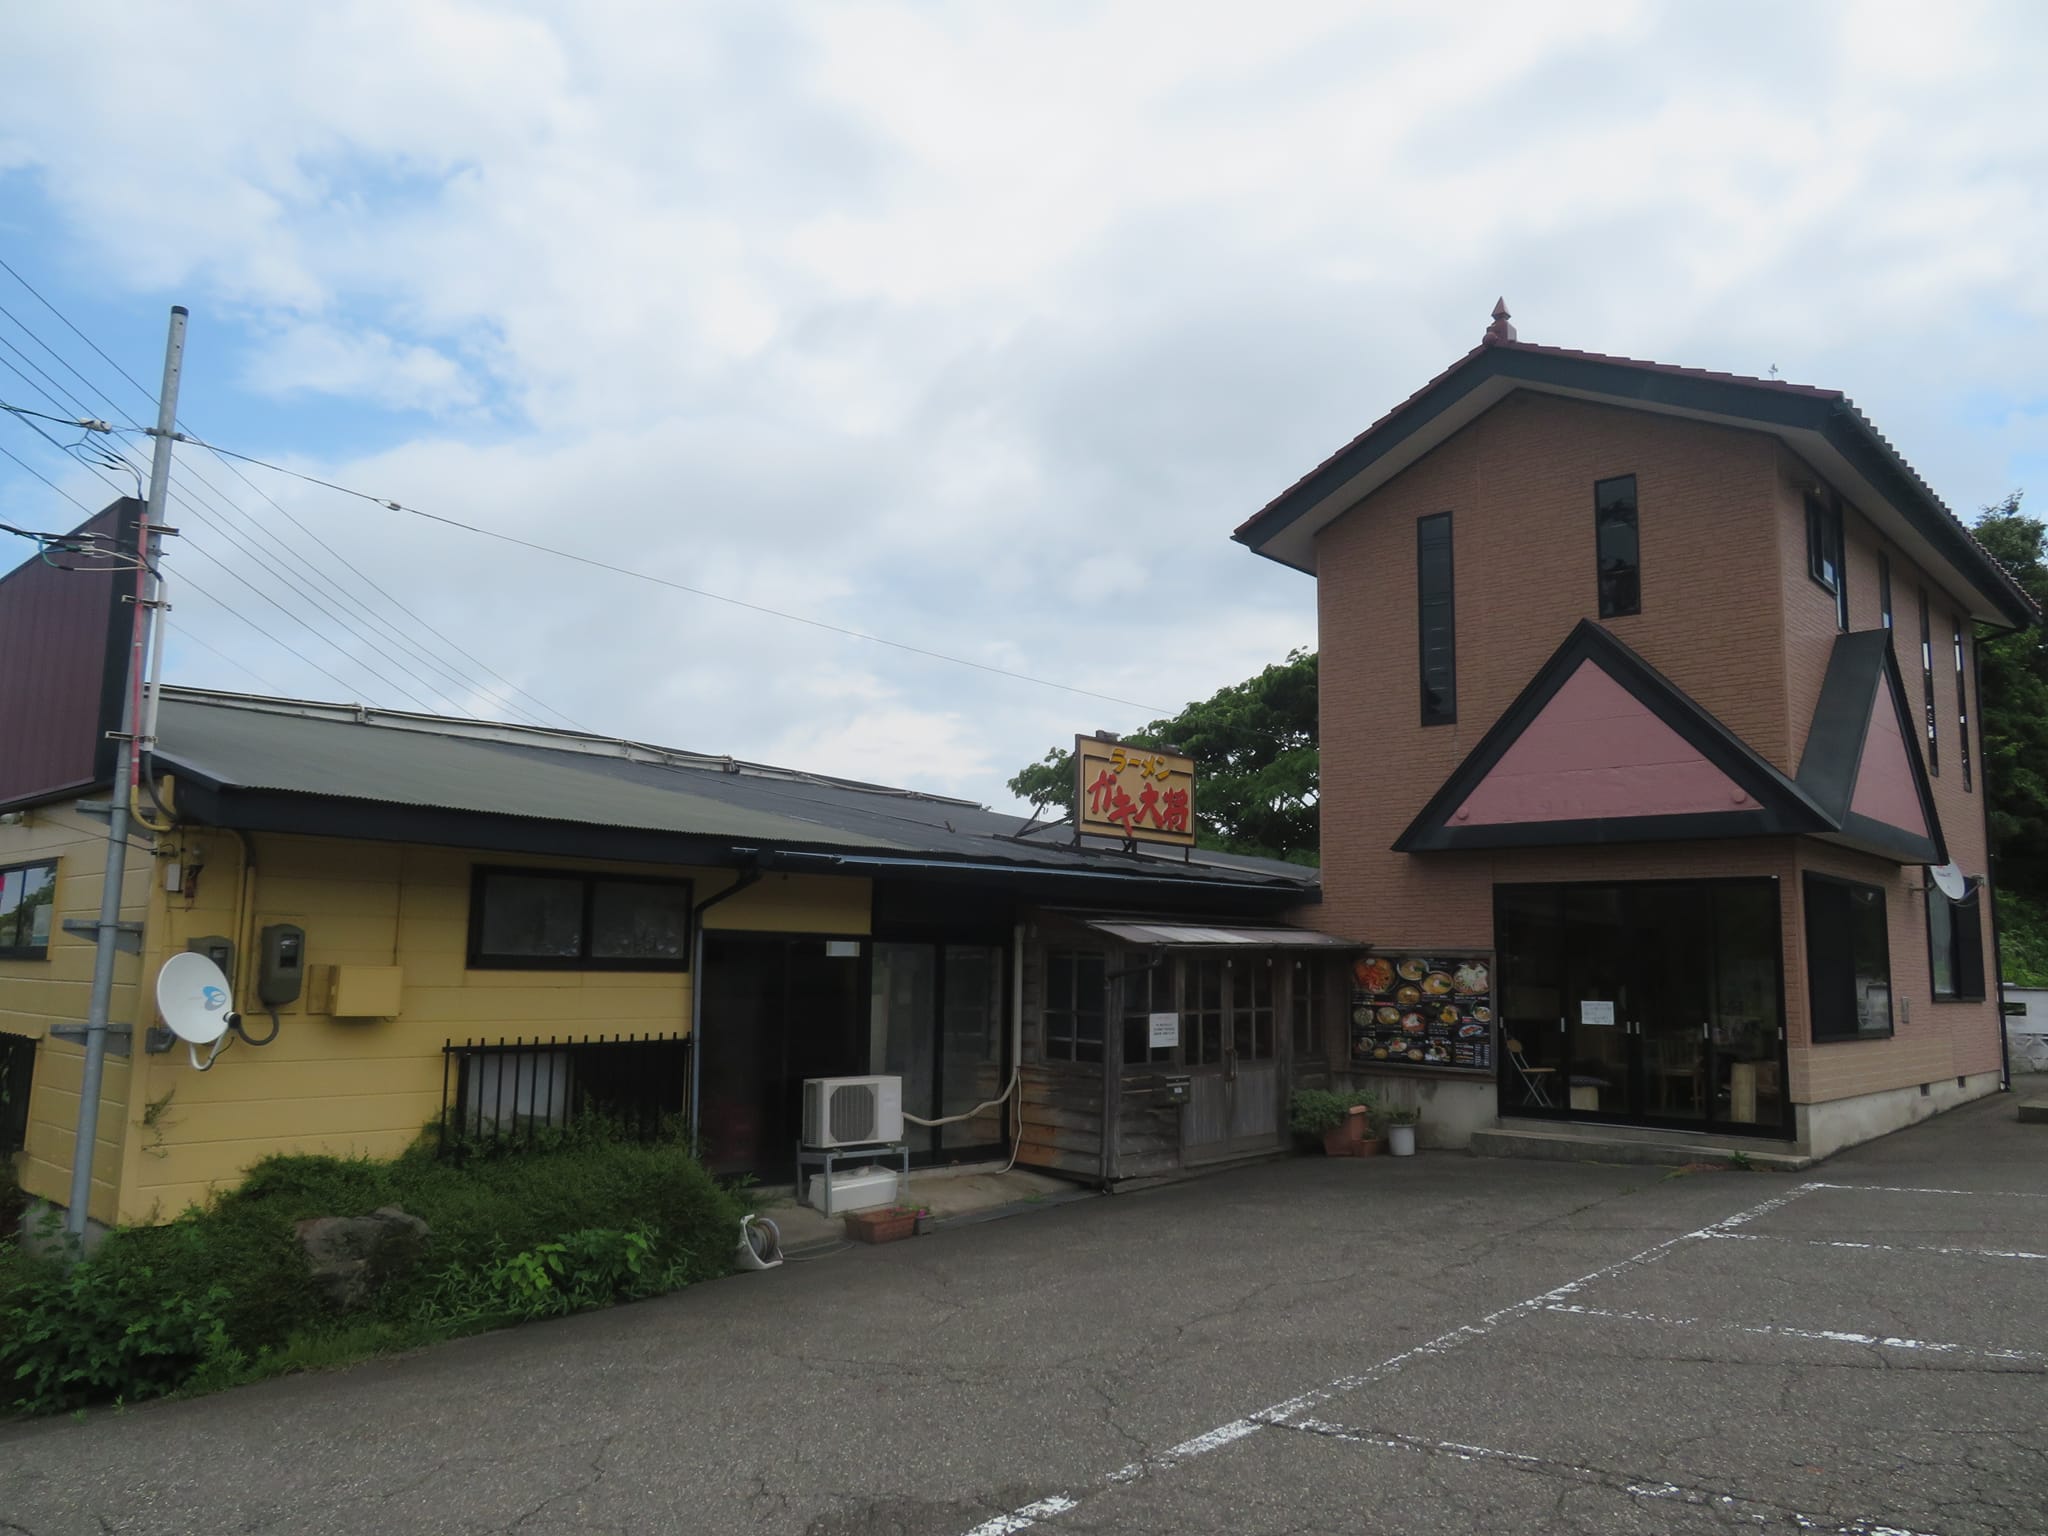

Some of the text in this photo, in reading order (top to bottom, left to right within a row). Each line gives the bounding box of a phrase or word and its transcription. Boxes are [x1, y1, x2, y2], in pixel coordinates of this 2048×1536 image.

[1110, 748, 1170, 781] ラーメン
[1087, 769, 1188, 837] ガキ大将
